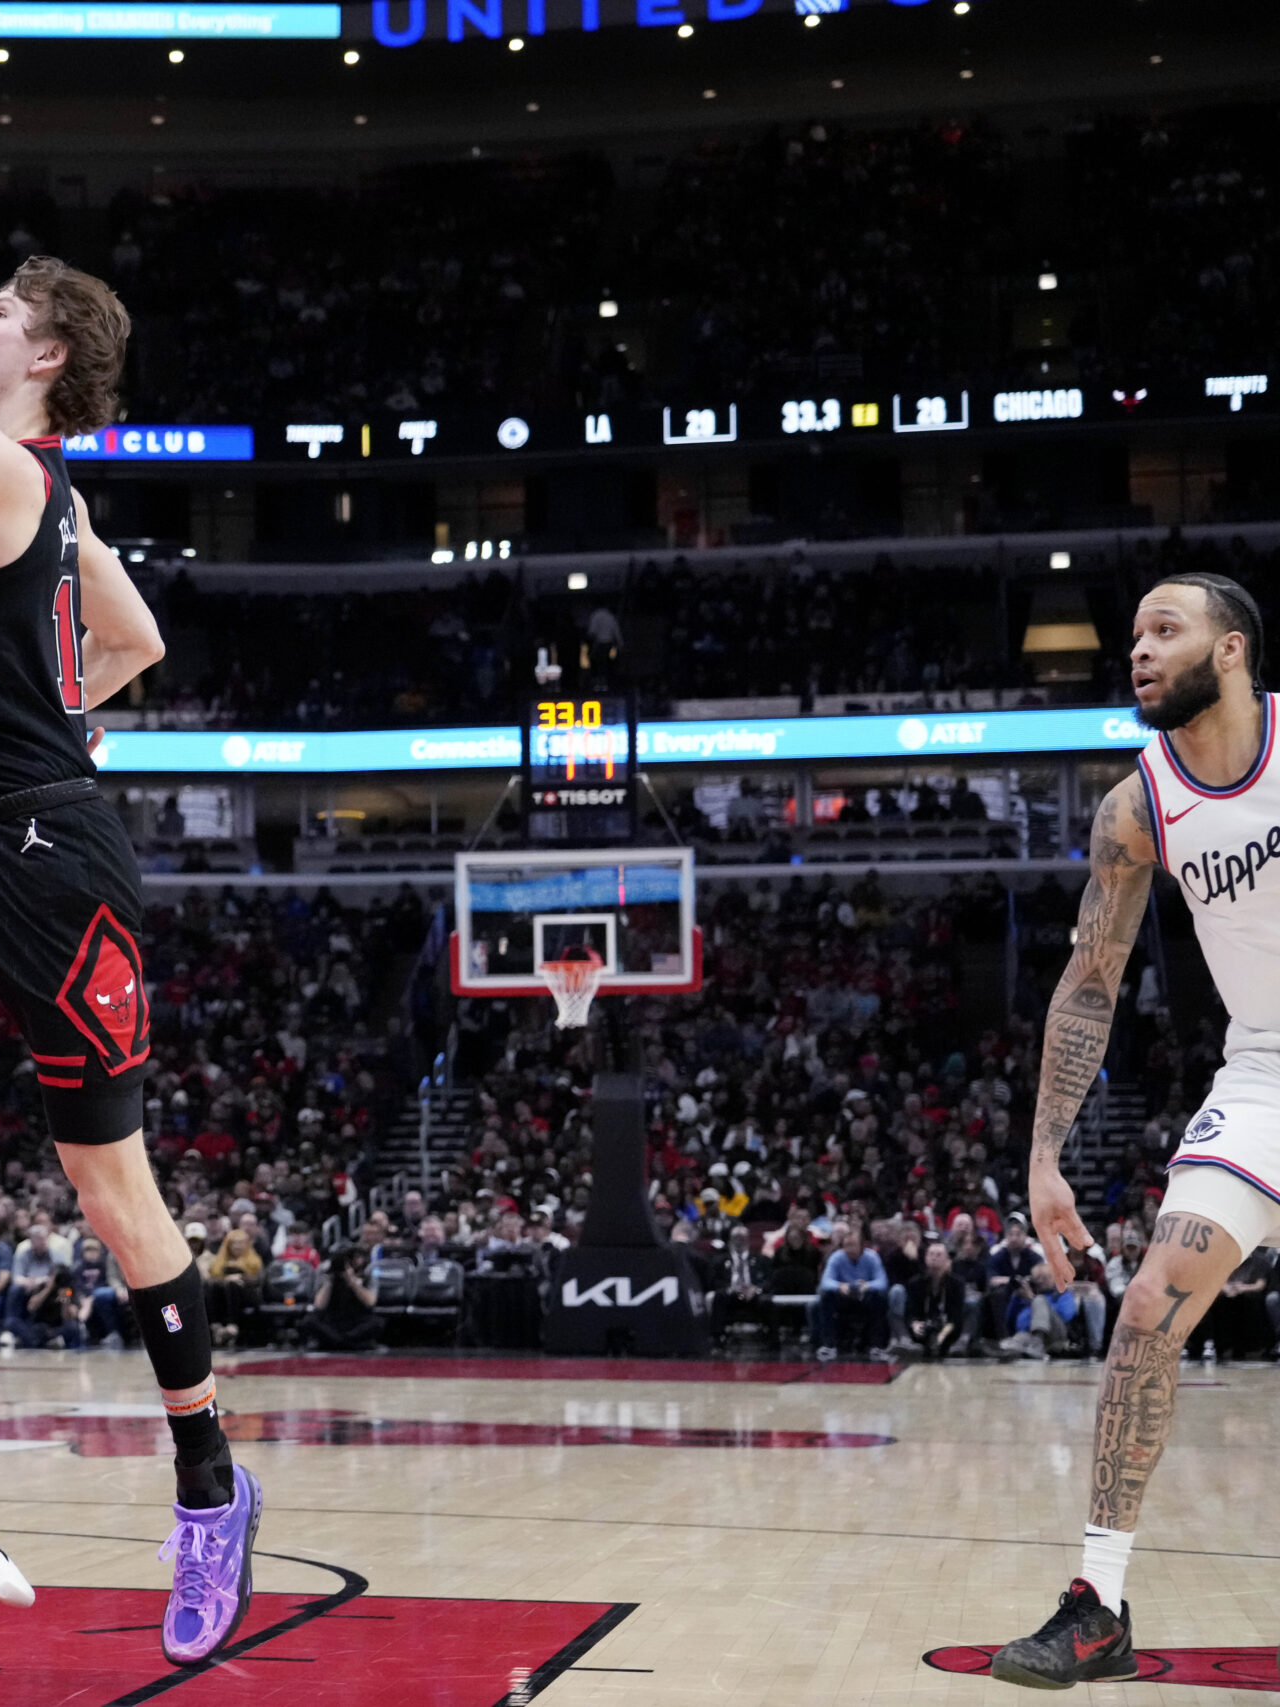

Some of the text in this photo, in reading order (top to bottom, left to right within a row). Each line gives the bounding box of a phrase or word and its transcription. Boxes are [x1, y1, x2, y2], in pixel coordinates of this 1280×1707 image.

[993, 388, 1083, 423] CHICAGO
[123, 430, 206, 454] CLUB
[584, 413, 613, 444] LA
[537, 701, 602, 731] 33.0
[653, 729, 778, 757] Everything
[930, 721, 988, 745] AT&T
[252, 740, 305, 763] AT&T
[558, 788, 627, 806] TISSOT
[1180, 1220, 1214, 1254] US
[562, 1276, 679, 1307] KIA
[1155, 1283, 1193, 1335] 7
